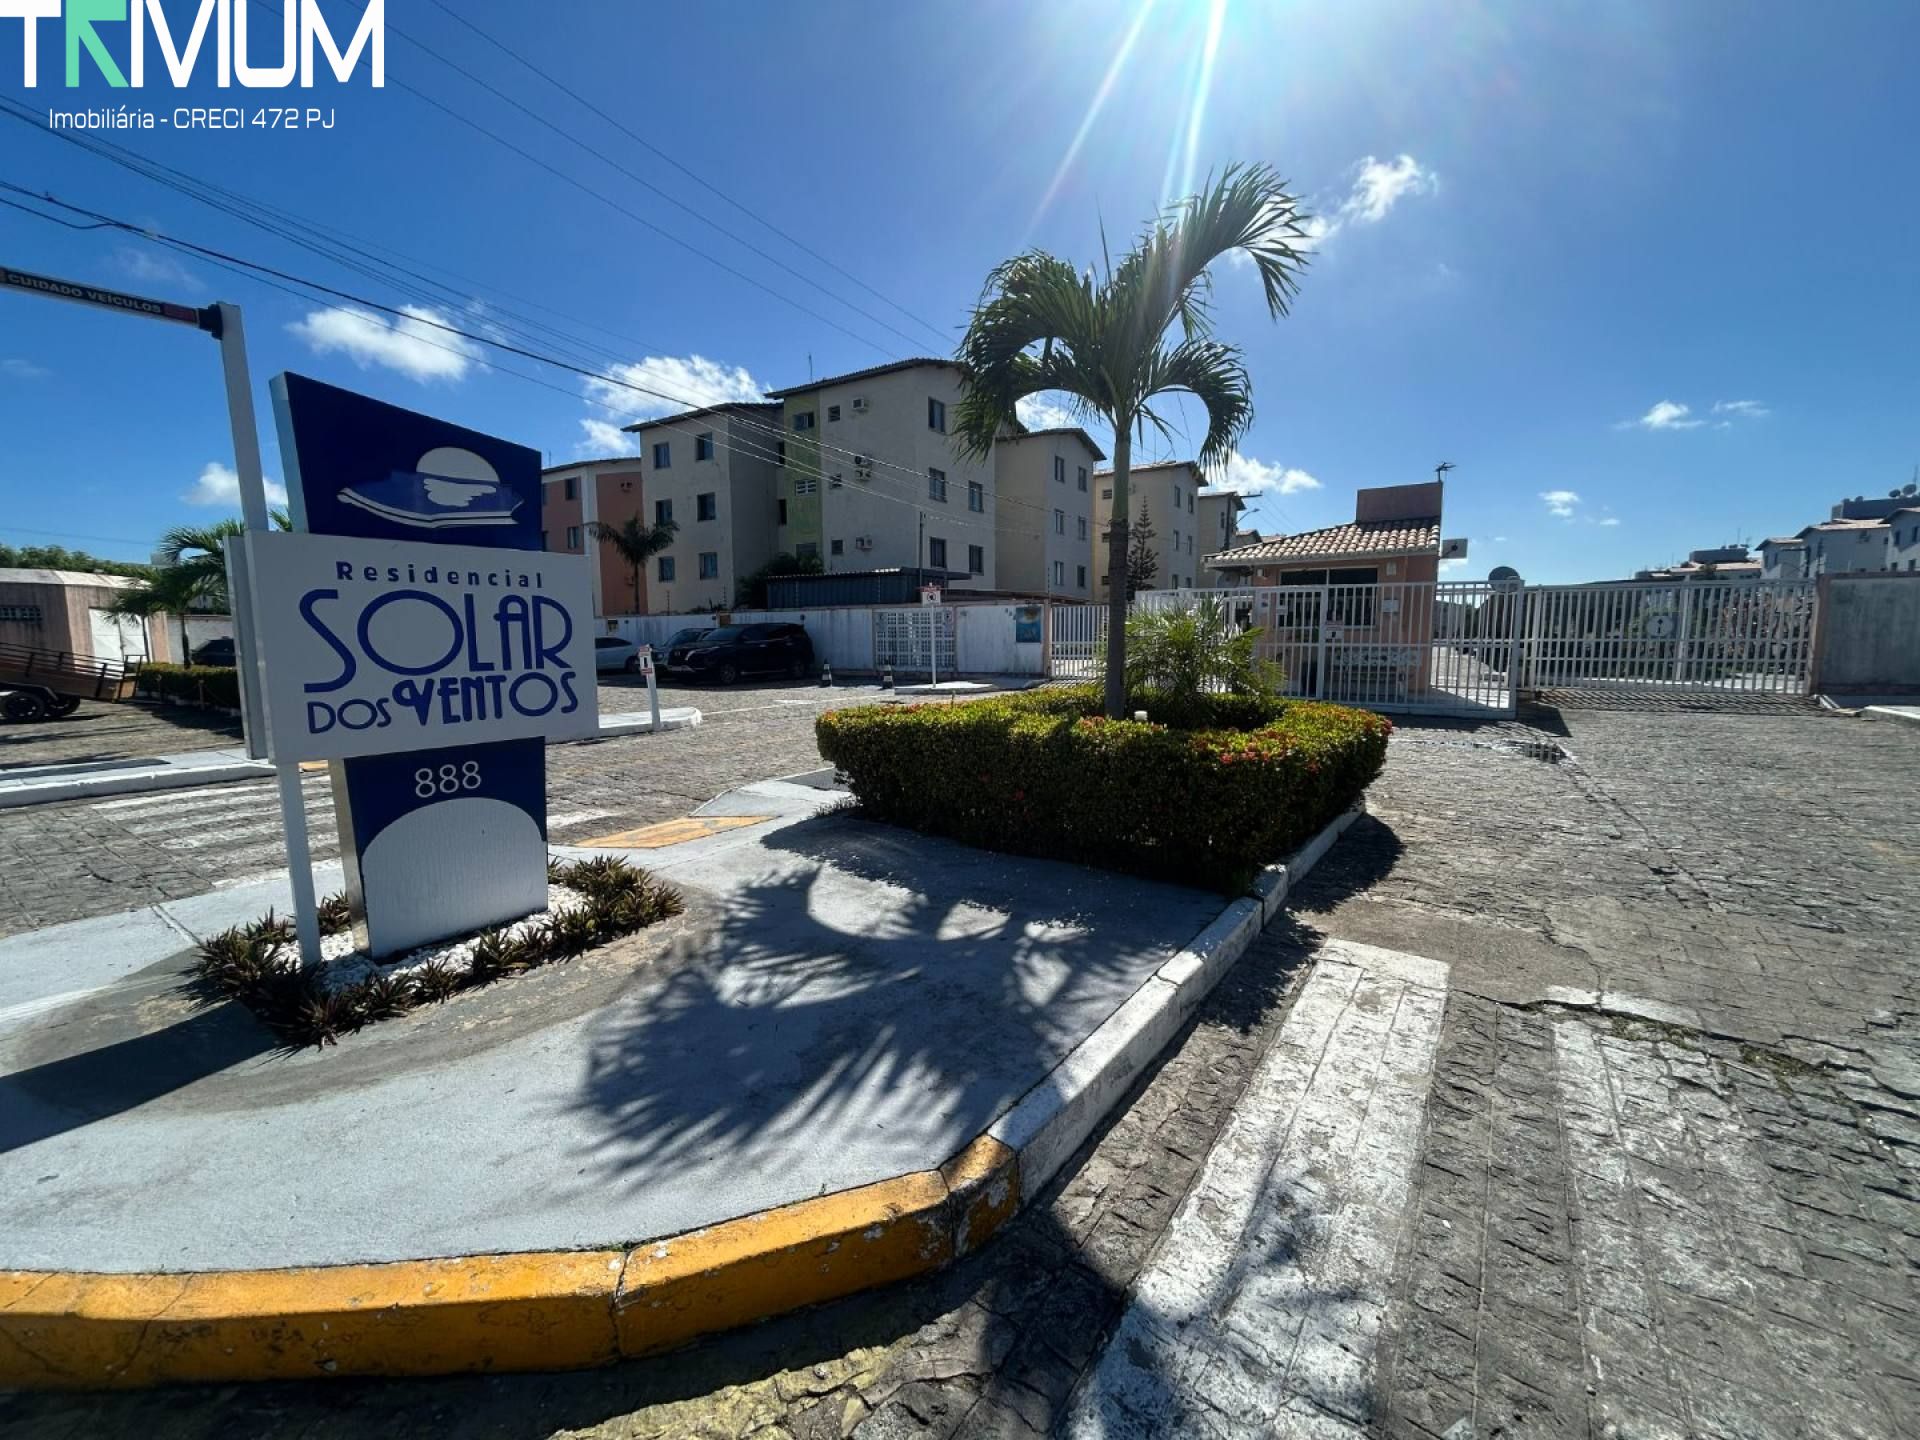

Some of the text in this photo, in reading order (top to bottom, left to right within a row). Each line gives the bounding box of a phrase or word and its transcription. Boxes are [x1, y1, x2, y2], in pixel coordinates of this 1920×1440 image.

[8, 273, 83, 297] CUIDADO
[336, 561, 542, 588] Residencial
[299, 589, 573, 693] SOLAR
[307, 671, 578, 734] DOS VENTOS
[414, 761, 482, 798] 888
